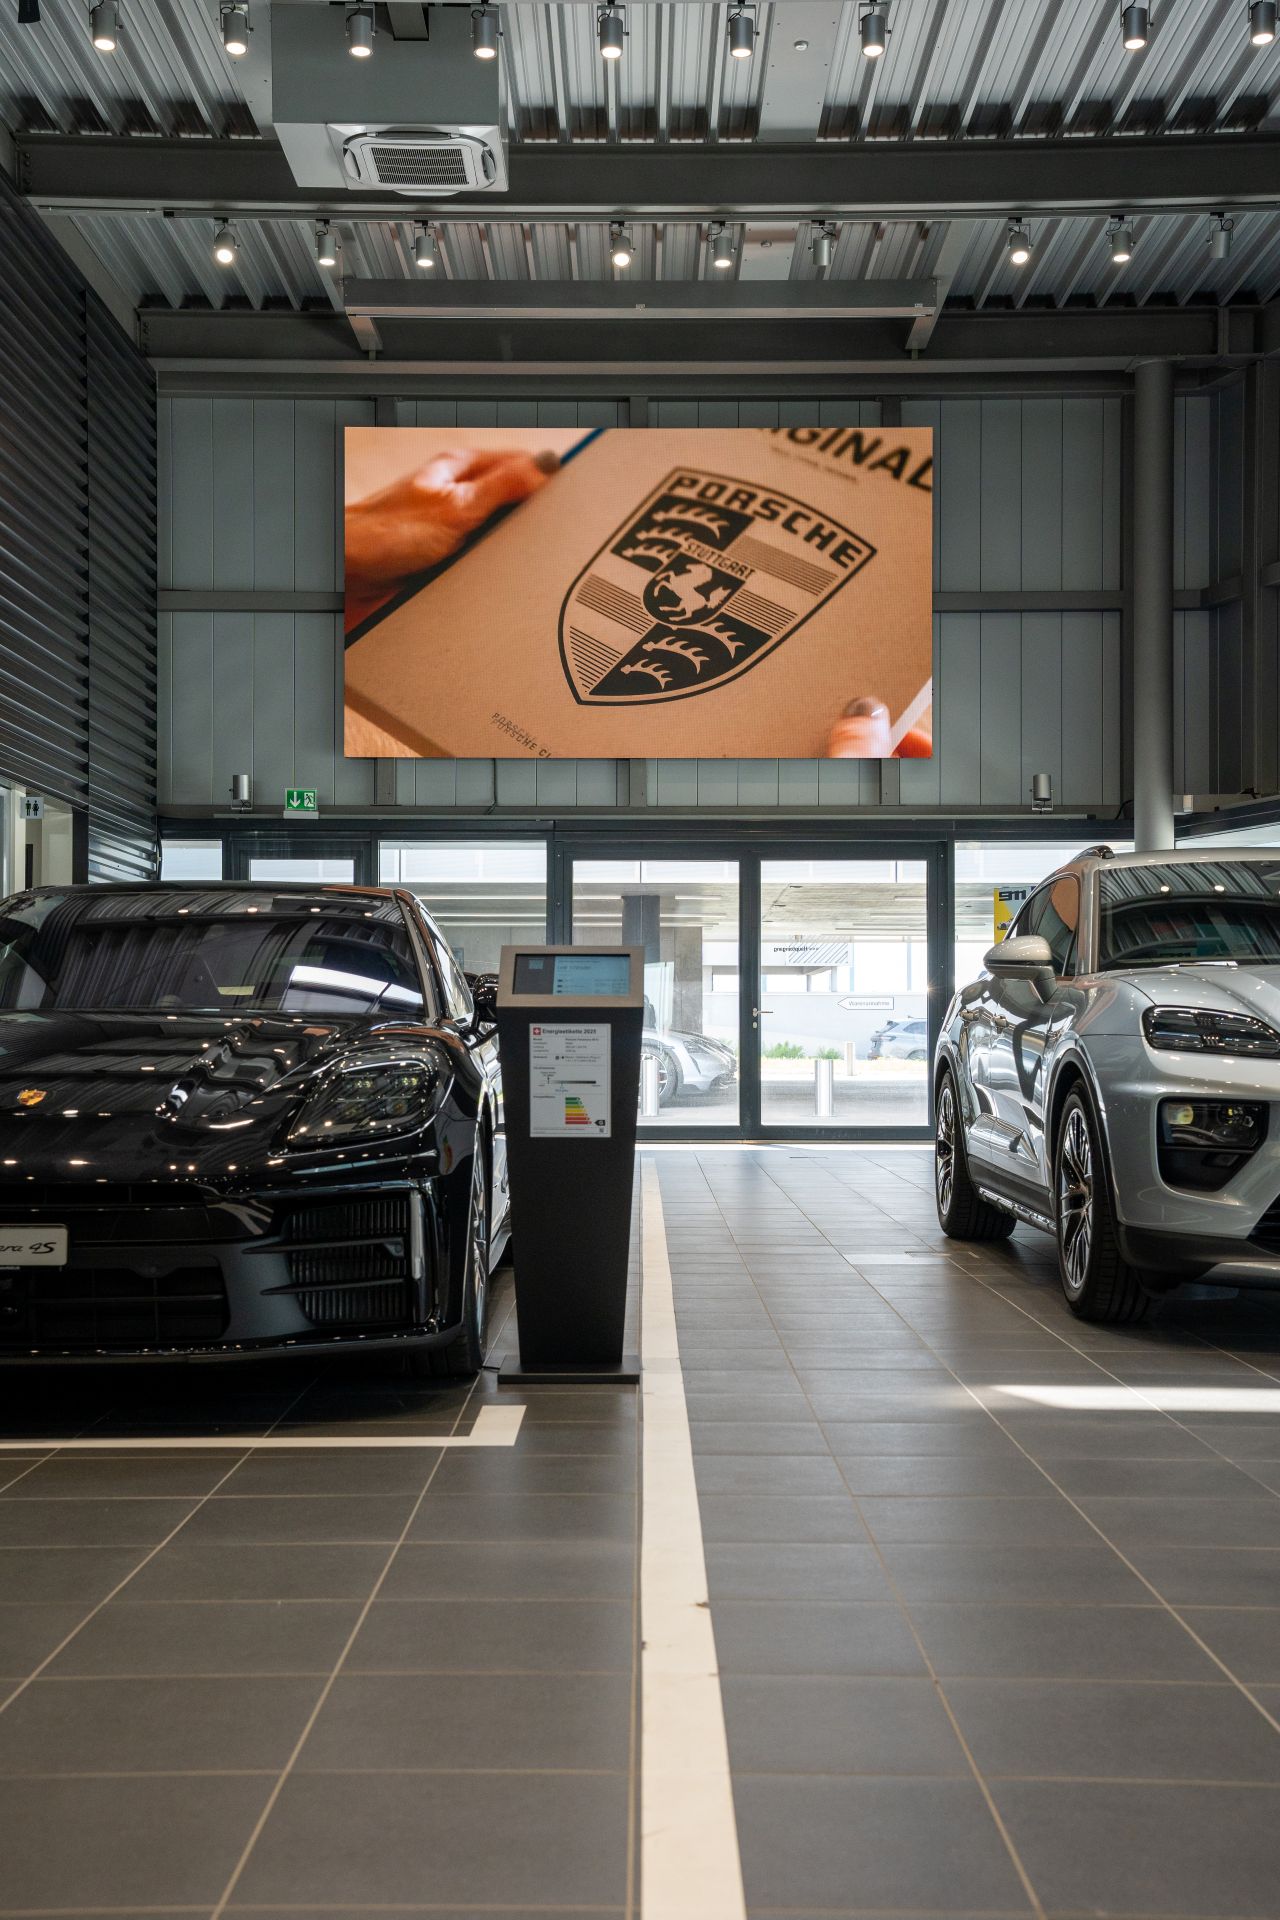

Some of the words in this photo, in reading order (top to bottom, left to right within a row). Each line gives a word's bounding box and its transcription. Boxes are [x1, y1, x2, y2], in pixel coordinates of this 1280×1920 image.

[667, 476, 862, 569] PORSCHE
[686, 541, 756, 580] STUTTGART
[998, 889, 1026, 901] 911
[29, 1241, 57, 1254] 4S
